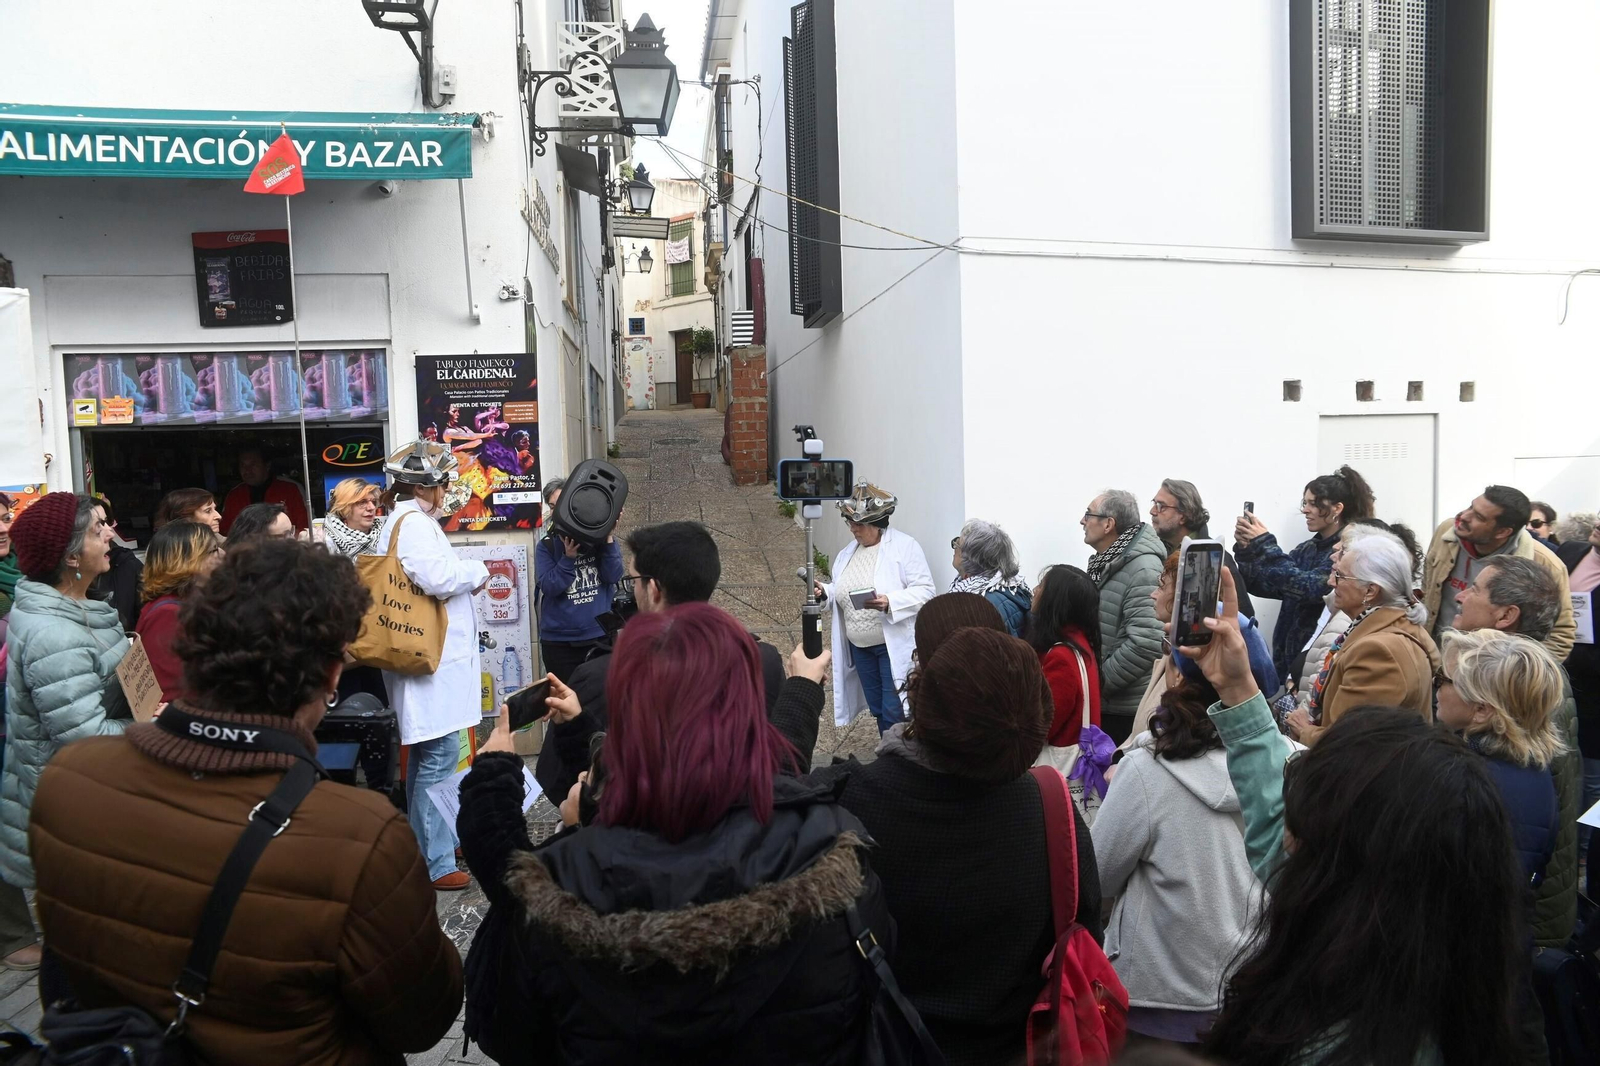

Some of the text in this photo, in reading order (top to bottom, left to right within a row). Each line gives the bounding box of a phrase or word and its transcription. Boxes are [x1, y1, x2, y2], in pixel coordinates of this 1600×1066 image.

[292, 140, 316, 167] Y
[325, 140, 444, 168] BAZAR
[258, 157, 288, 178] SOS
[235, 255, 291, 268] BEBIDAS
[436, 358, 514, 370] TABLAO FLAMENCO
[436, 368, 516, 380] EL CARDENAL
[388, 572, 406, 590] We
[573, 596, 594, 605] SUCKS!
[581, 590, 598, 598] PLACE
[382, 594, 412, 613] Love
[376, 614, 424, 637] Stories
[189, 721, 260, 744] SONY
